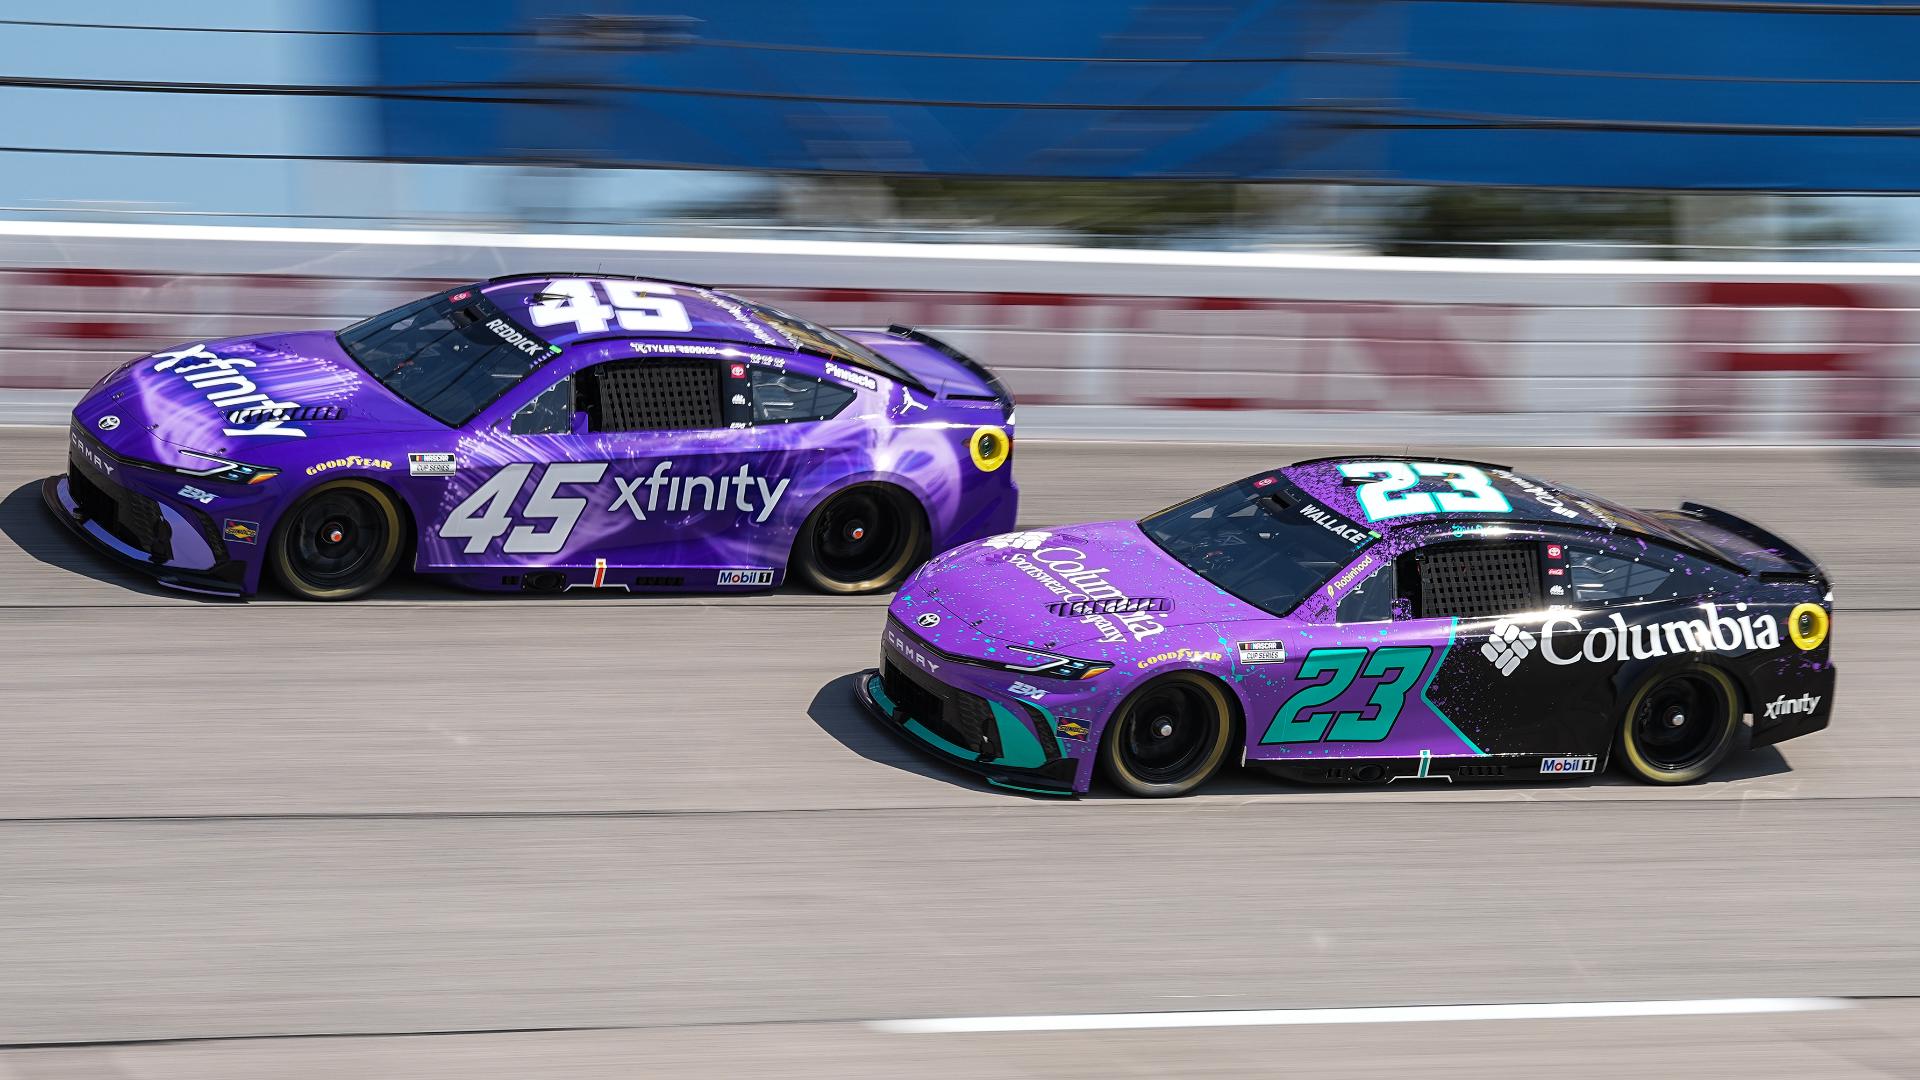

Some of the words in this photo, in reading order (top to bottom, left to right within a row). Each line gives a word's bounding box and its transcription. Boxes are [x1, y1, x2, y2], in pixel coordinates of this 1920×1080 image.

[529, 279, 693, 335] 45
[485, 317, 545, 358] REDDICK
[825, 361, 878, 391] Pinnacle
[71, 432, 115, 476] CAMRY
[305, 455, 393, 476] GOODYEAR
[438, 461, 609, 555] 45
[607, 460, 792, 523] xfinity
[1335, 462, 1513, 523] 23
[1299, 503, 1368, 545] WALLACE
[720, 572, 757, 584] Mobil
[1333, 554, 1374, 591] Robinhood
[887, 630, 940, 674] CAMRY
[1252, 642, 1277, 650] NASCAR
[1540, 602, 1781, 665] Columbia
[1246, 652, 1258, 660] CUP
[1258, 652, 1280, 660] SERIES
[1257, 644, 1434, 746] 23
[1763, 692, 1822, 720] xfinity
[1543, 759, 1580, 771] Mobil
